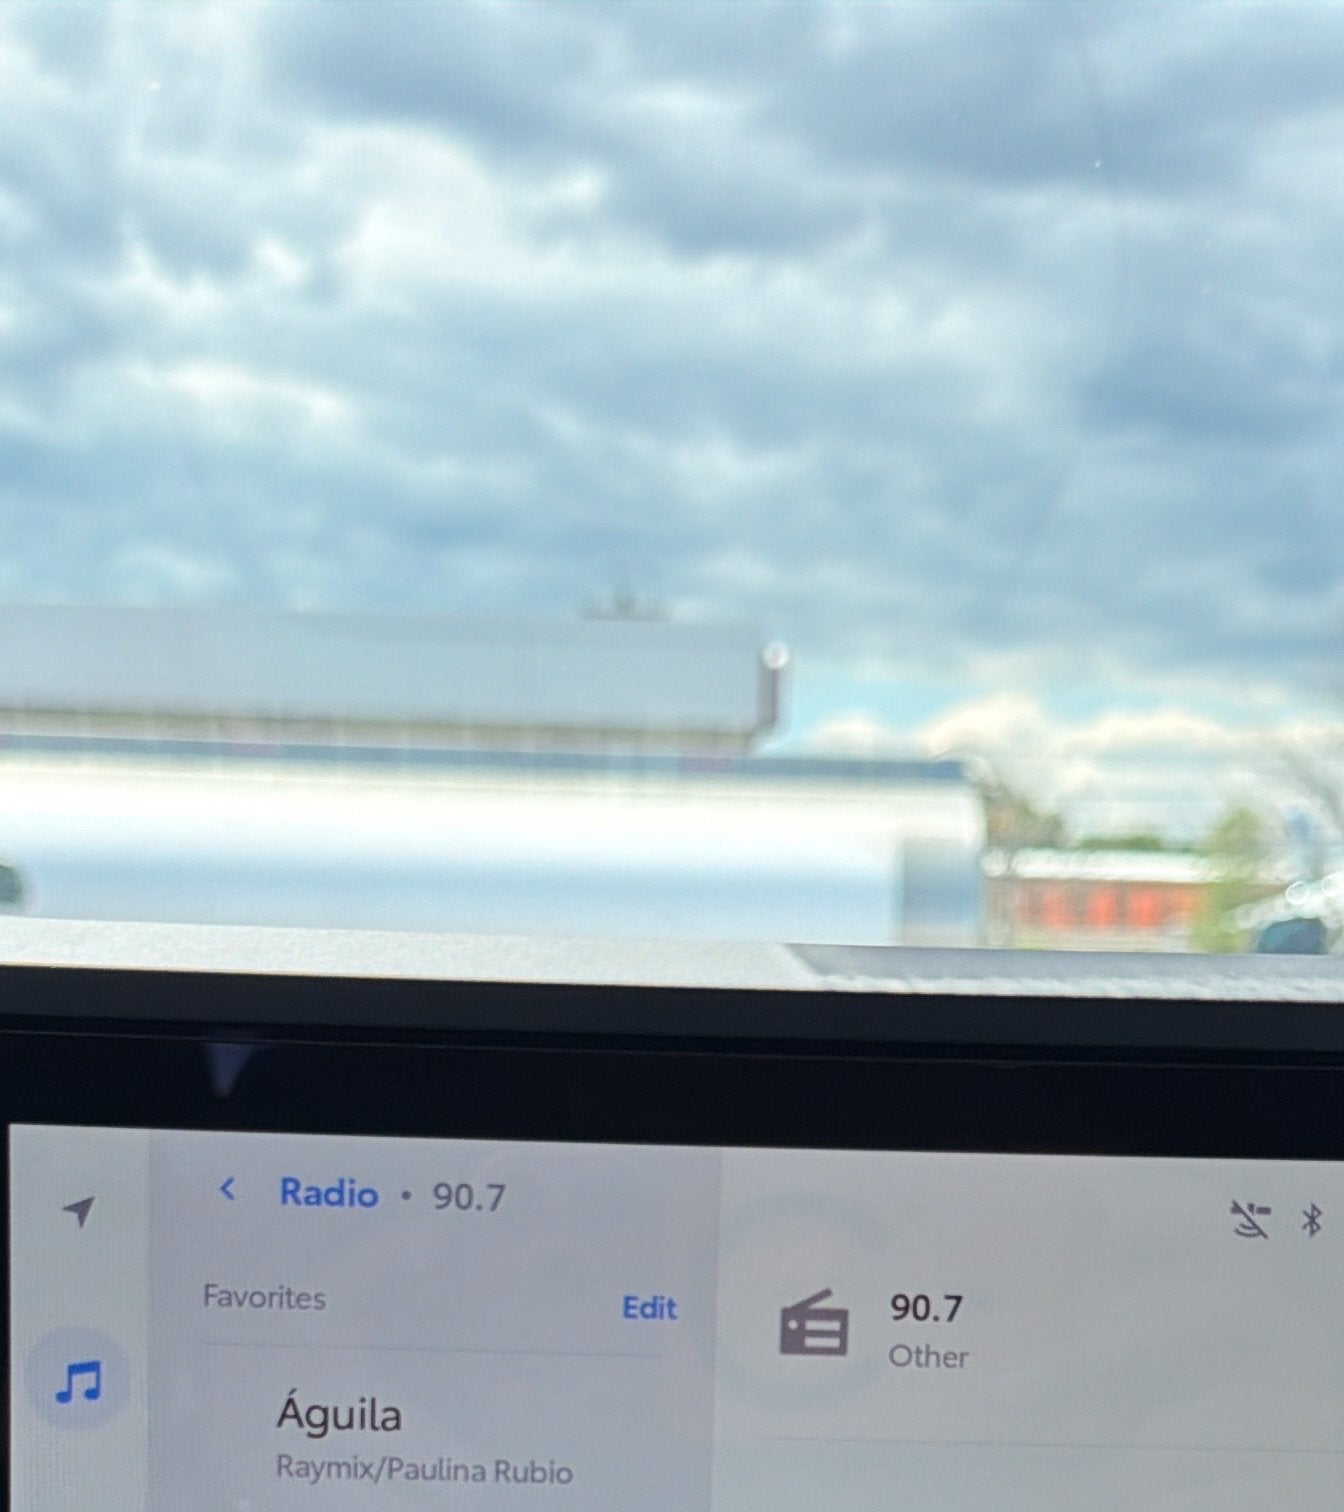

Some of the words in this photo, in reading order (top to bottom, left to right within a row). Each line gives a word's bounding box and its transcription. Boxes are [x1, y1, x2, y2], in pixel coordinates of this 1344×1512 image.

[279, 1176, 380, 1209] Radio
[432, 1181, 507, 1212] 90.7
[203, 1284, 326, 1312] Favorites
[622, 1295, 678, 1321] Edit
[890, 1293, 963, 1324] 90.7
[889, 1343, 970, 1370] Other
[276, 1387, 401, 1439] Águila
[276, 1455, 486, 1485] Raymix/Paulina
[494, 1459, 574, 1486] Rubio
